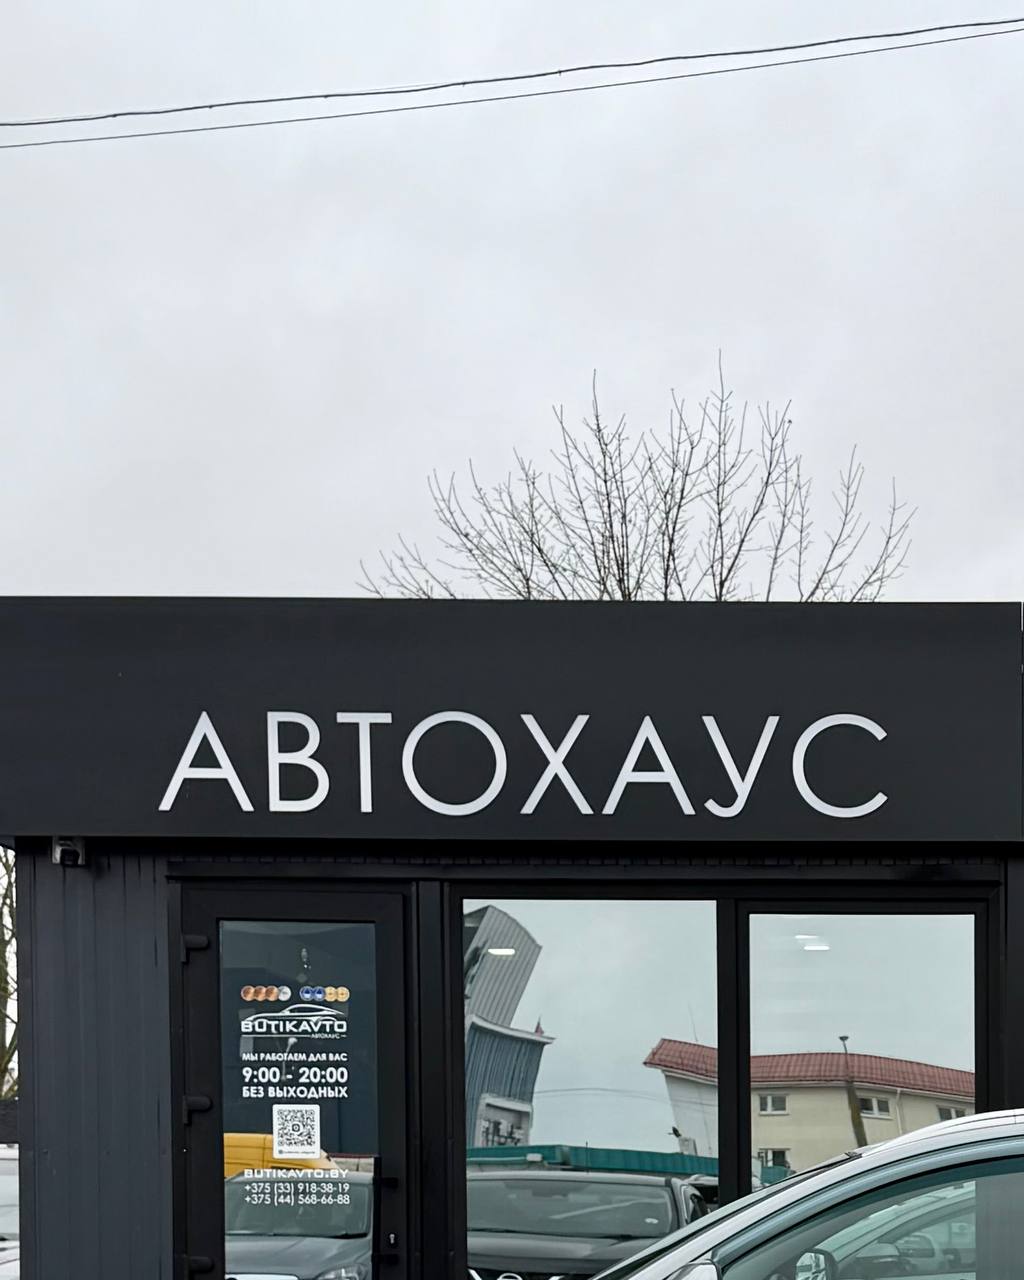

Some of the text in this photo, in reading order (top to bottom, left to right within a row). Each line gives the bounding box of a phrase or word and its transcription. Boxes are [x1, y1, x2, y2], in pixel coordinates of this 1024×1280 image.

[158, 710, 888, 818] АВТОХАУС
[241, 1020, 347, 1032] BUTIKAVTO
[242, 1053, 348, 1062] МЫ РАБОТАЕМ ДЛЯ ВАС
[242, 1067, 280, 1083] 9:00
[298, 1067, 348, 1083] 20:00
[242, 1086, 348, 1099] БЕЗ ВЫХОДНЫХ
[244, 1169, 349, 1178] BUTIKAVTO.BY
[244, 1182, 350, 1194] +375 (33) 918-38-19
[244, 1194, 350, 1206] +375 (44) 568-66-88
